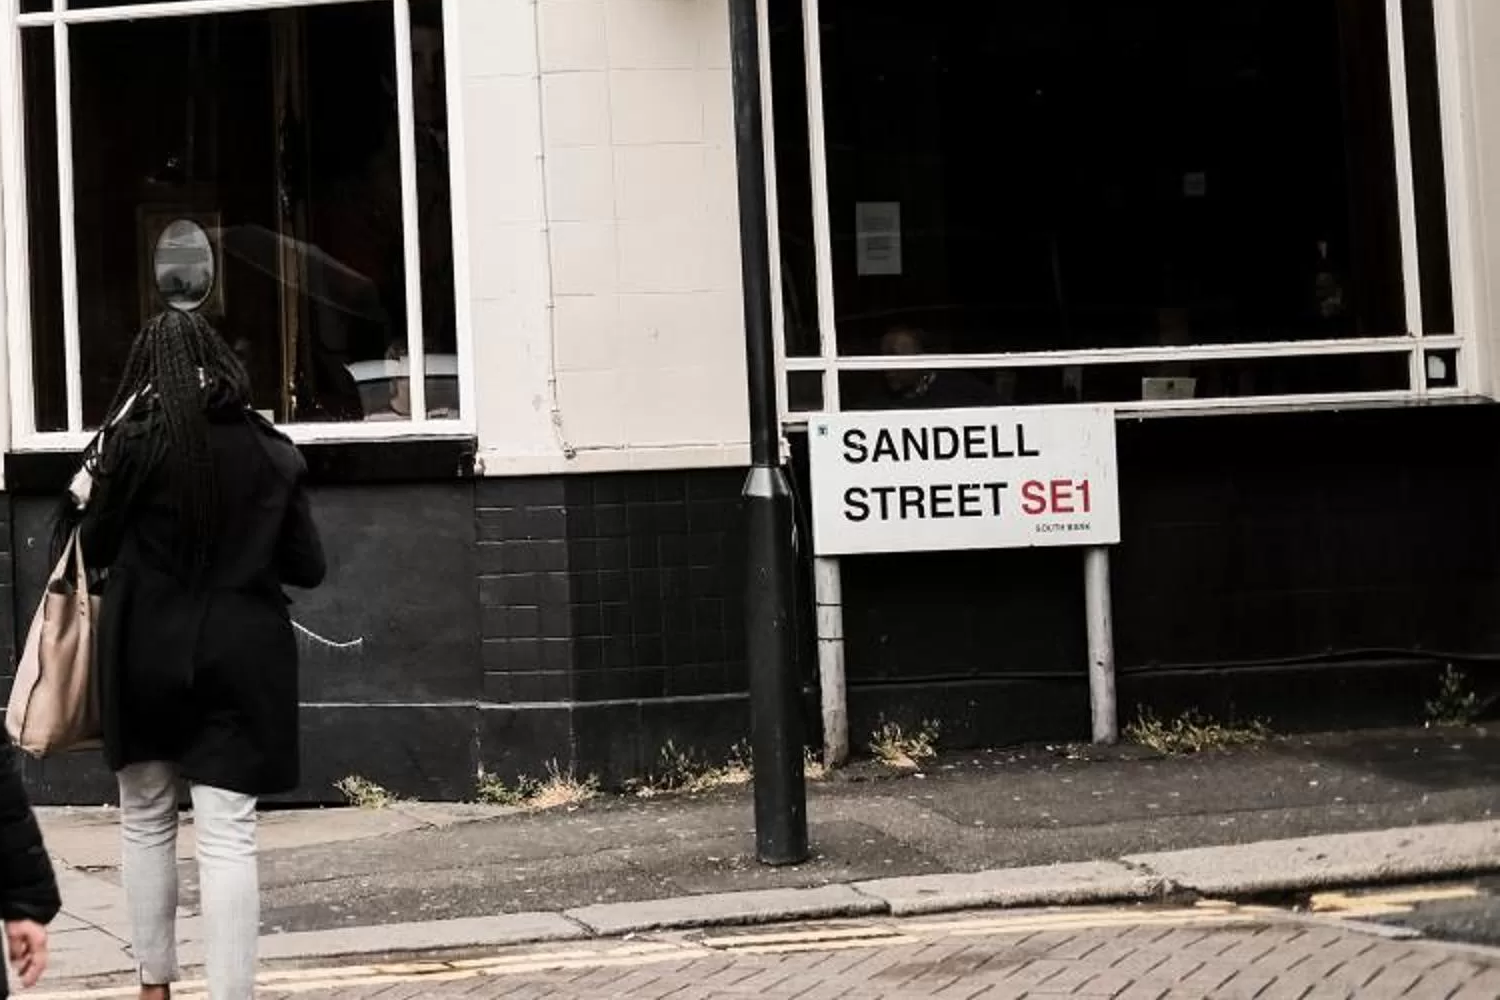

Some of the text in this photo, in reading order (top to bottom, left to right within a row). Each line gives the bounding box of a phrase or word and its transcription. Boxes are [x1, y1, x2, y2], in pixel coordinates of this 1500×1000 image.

[842, 423, 1041, 464] SANDELL
[843, 479, 1092, 522] STREET SE1
[1035, 523, 1065, 533] SOUTH
